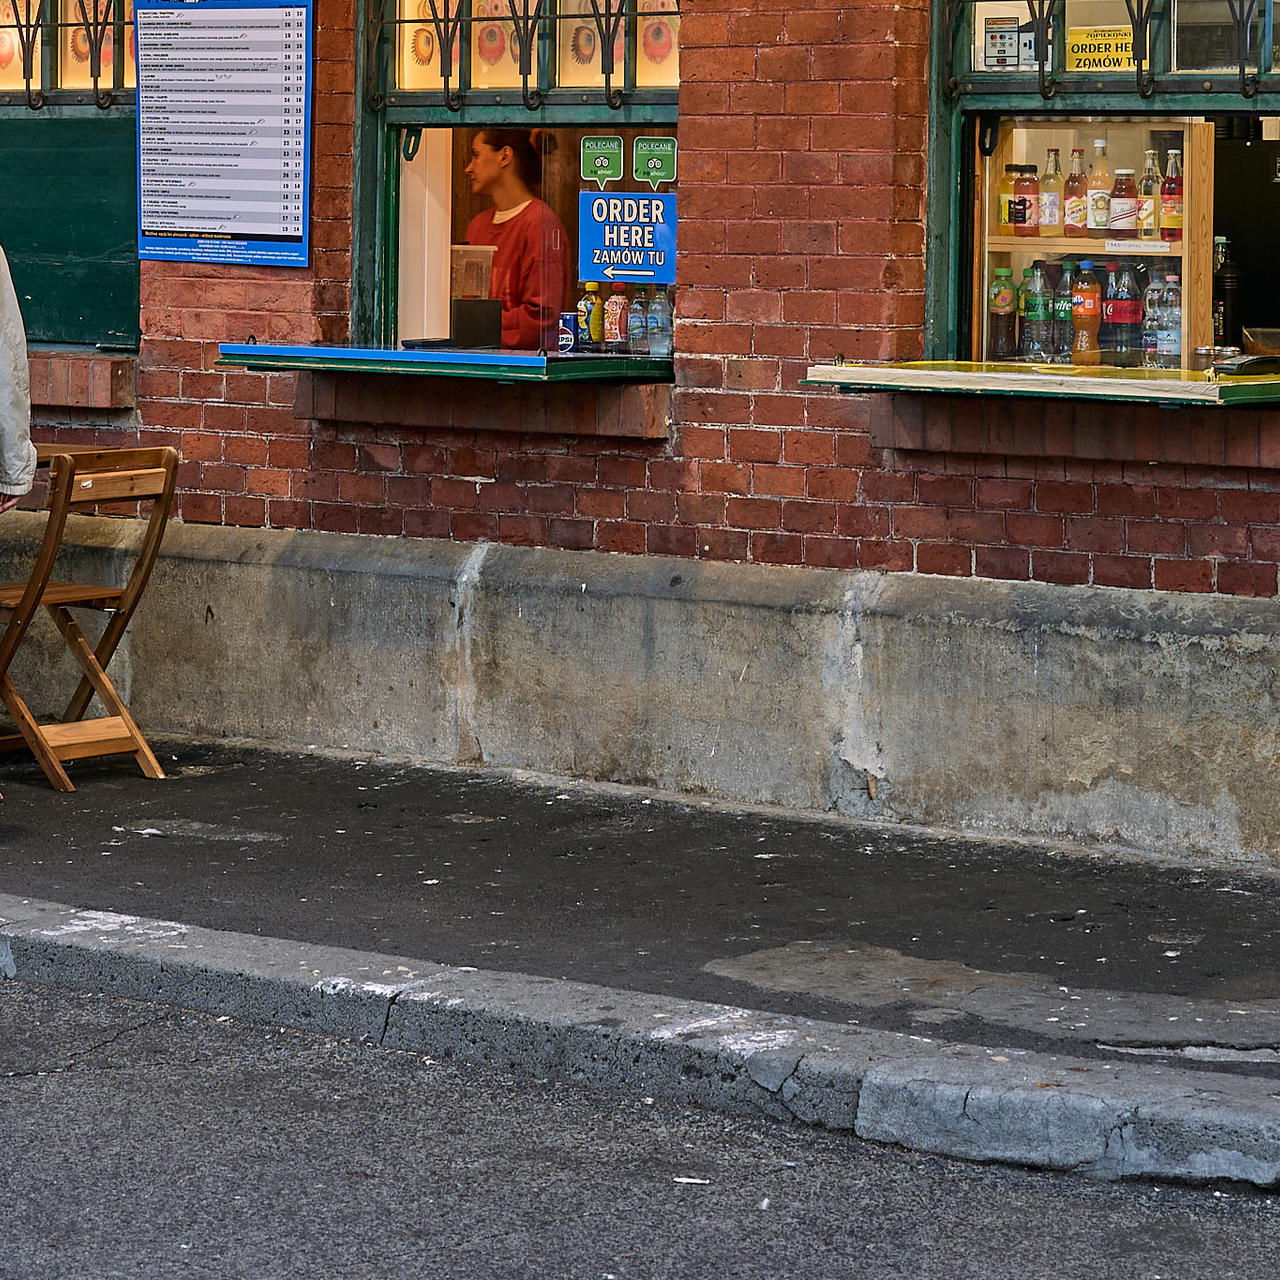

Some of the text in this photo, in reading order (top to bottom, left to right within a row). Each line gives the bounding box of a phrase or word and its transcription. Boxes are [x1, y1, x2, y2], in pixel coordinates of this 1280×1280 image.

[1071, 42, 1134, 54] ORDER HE
[1075, 55, 1123, 70] ZAMÓW
[638, 142, 673, 152] POLECANE
[592, 198, 665, 224] ORDER
[604, 224, 655, 249] HERE
[592, 248, 666, 266] ZAMÓW TU
[1055, 300, 1072, 311] rite
